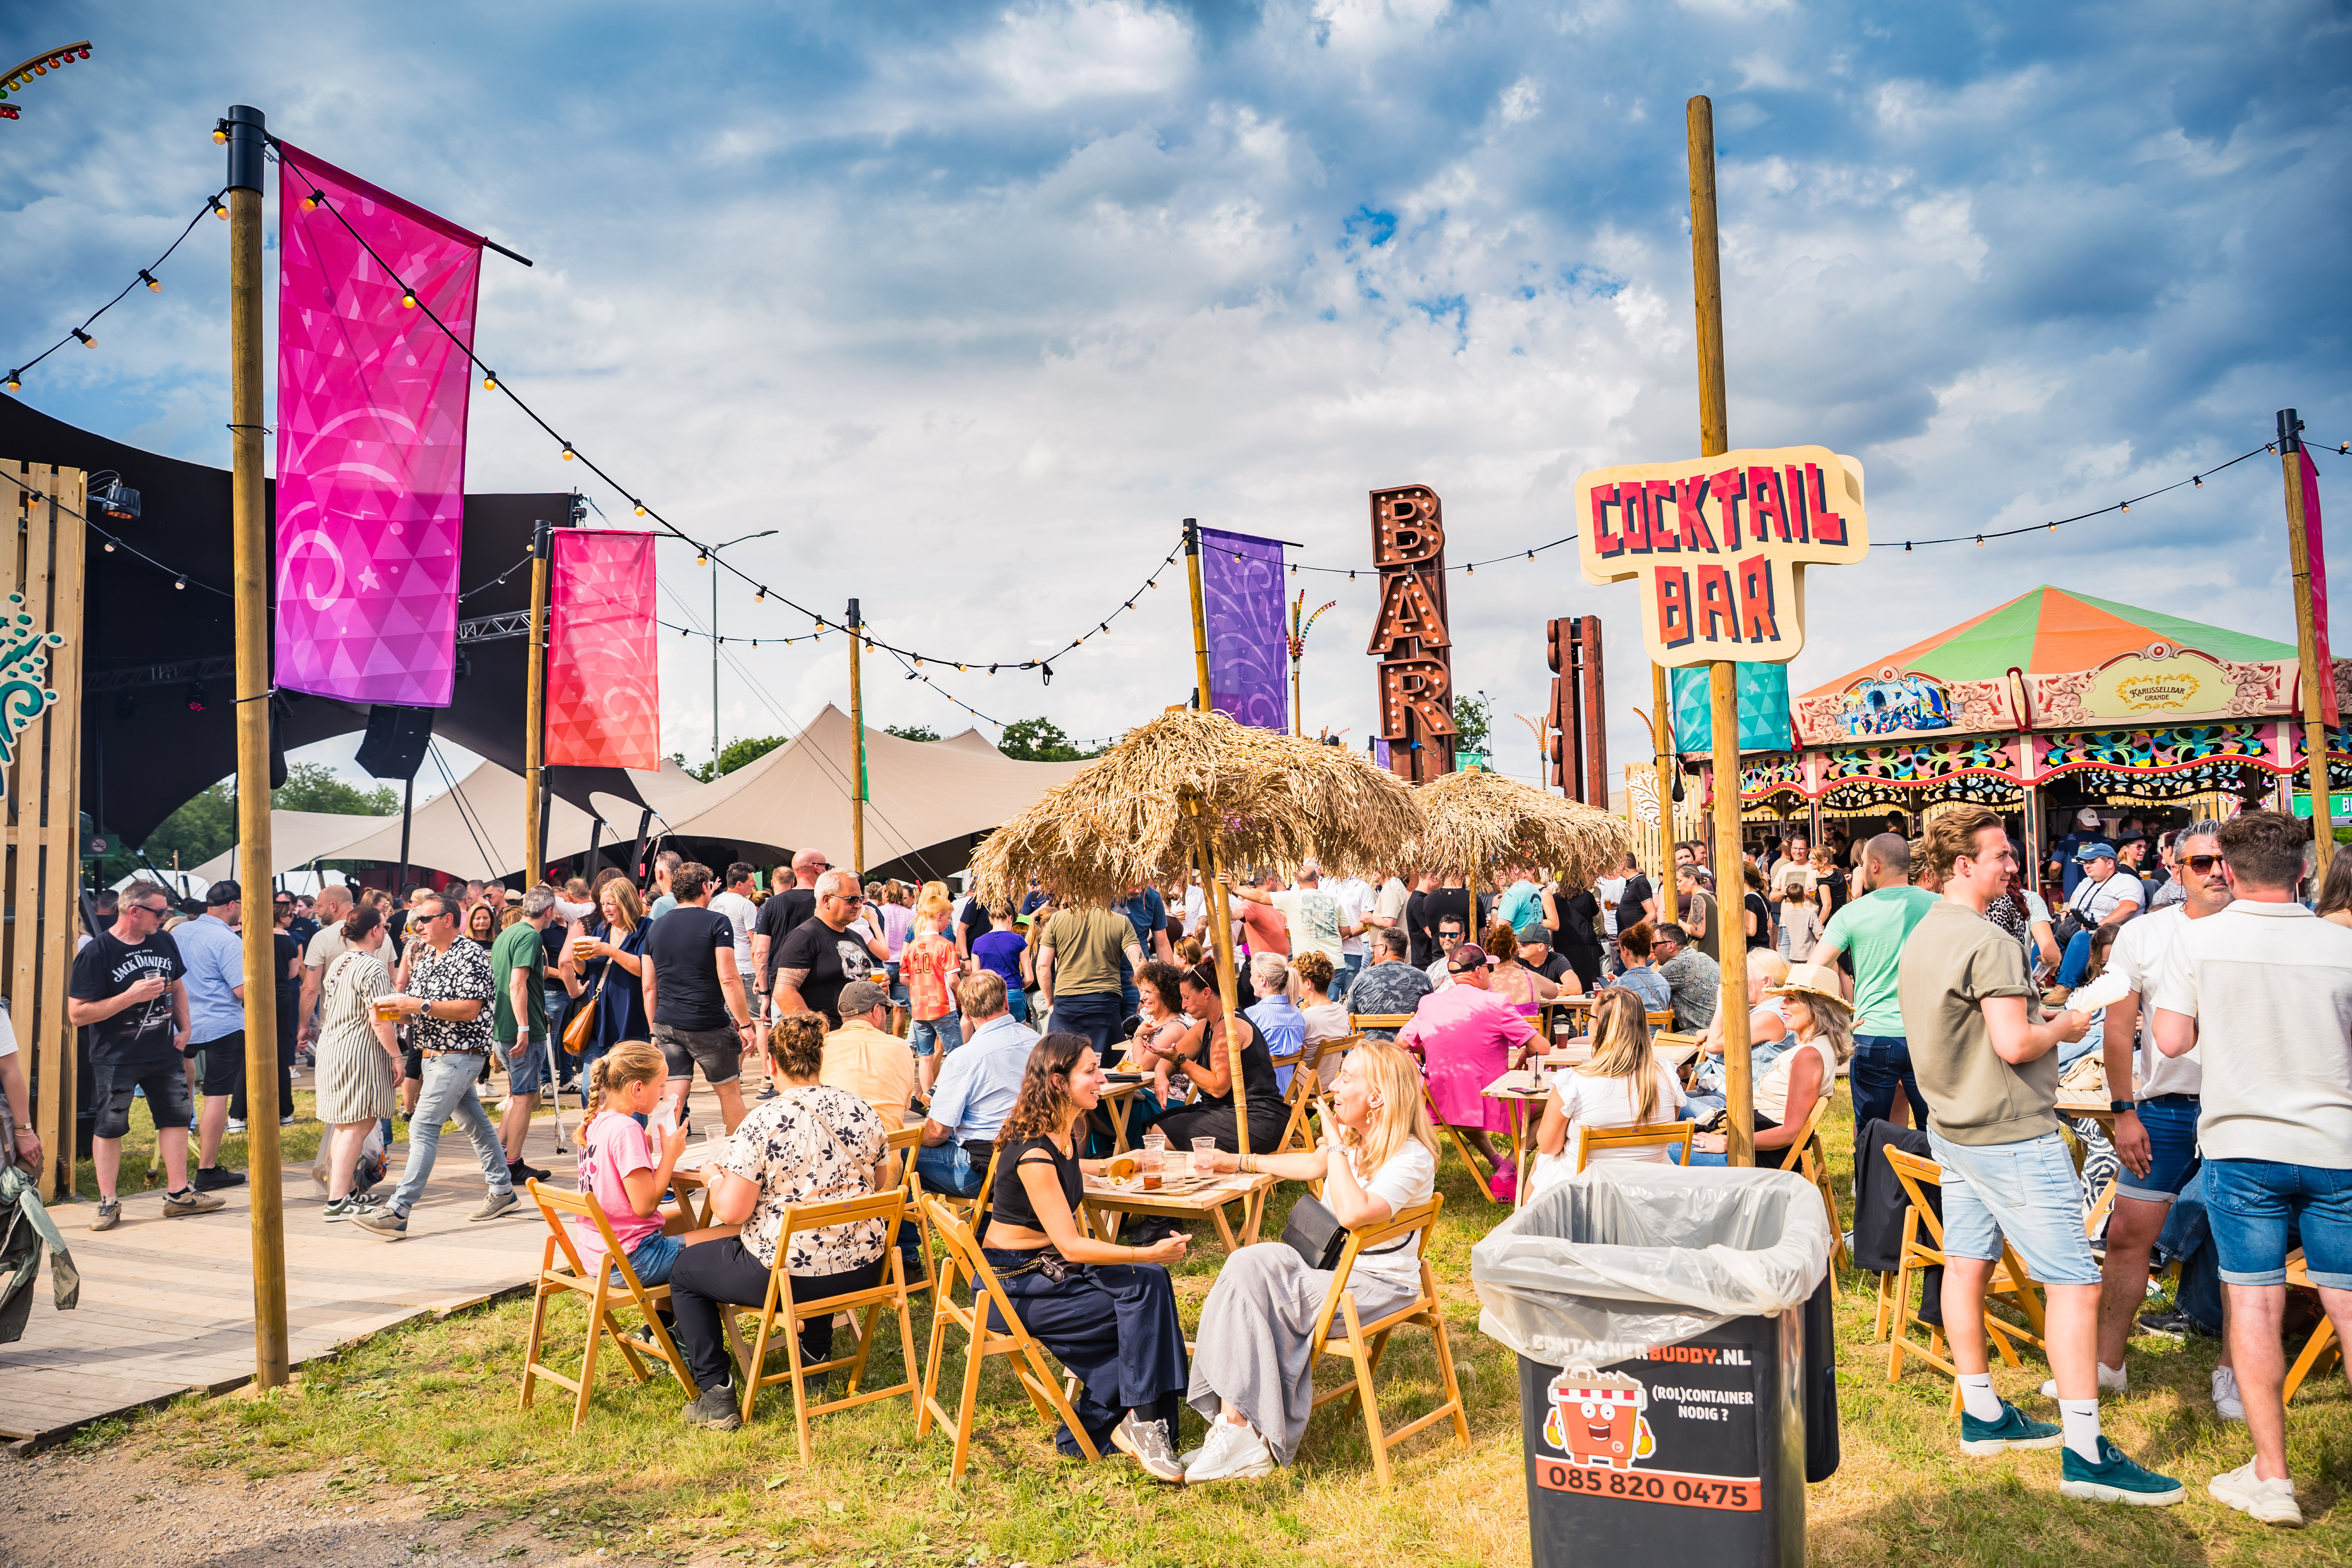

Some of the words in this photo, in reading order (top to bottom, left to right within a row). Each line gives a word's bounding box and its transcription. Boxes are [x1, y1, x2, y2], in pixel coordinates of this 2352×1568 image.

[1590, 462, 1848, 559] COCKTAIL
[1367, 484, 1460, 741] BAR
[1654, 553, 1782, 650] BAR
[2129, 686, 2185, 698] KARUSSELLBAR
[112, 959, 139, 983] JACK
[134, 955, 172, 971] DANIEL'S
[914, 953, 931, 974] 10
[1652, 1384, 1754, 1405] (ROL)CONTAINER
[1678, 1405, 1719, 1421] NODIG
[1721, 1408, 1729, 1422] ?
[1549, 1466, 1602, 1491] 085
[1610, 1474, 1664, 1498] 820
[1673, 1481, 1748, 1507] 0475
